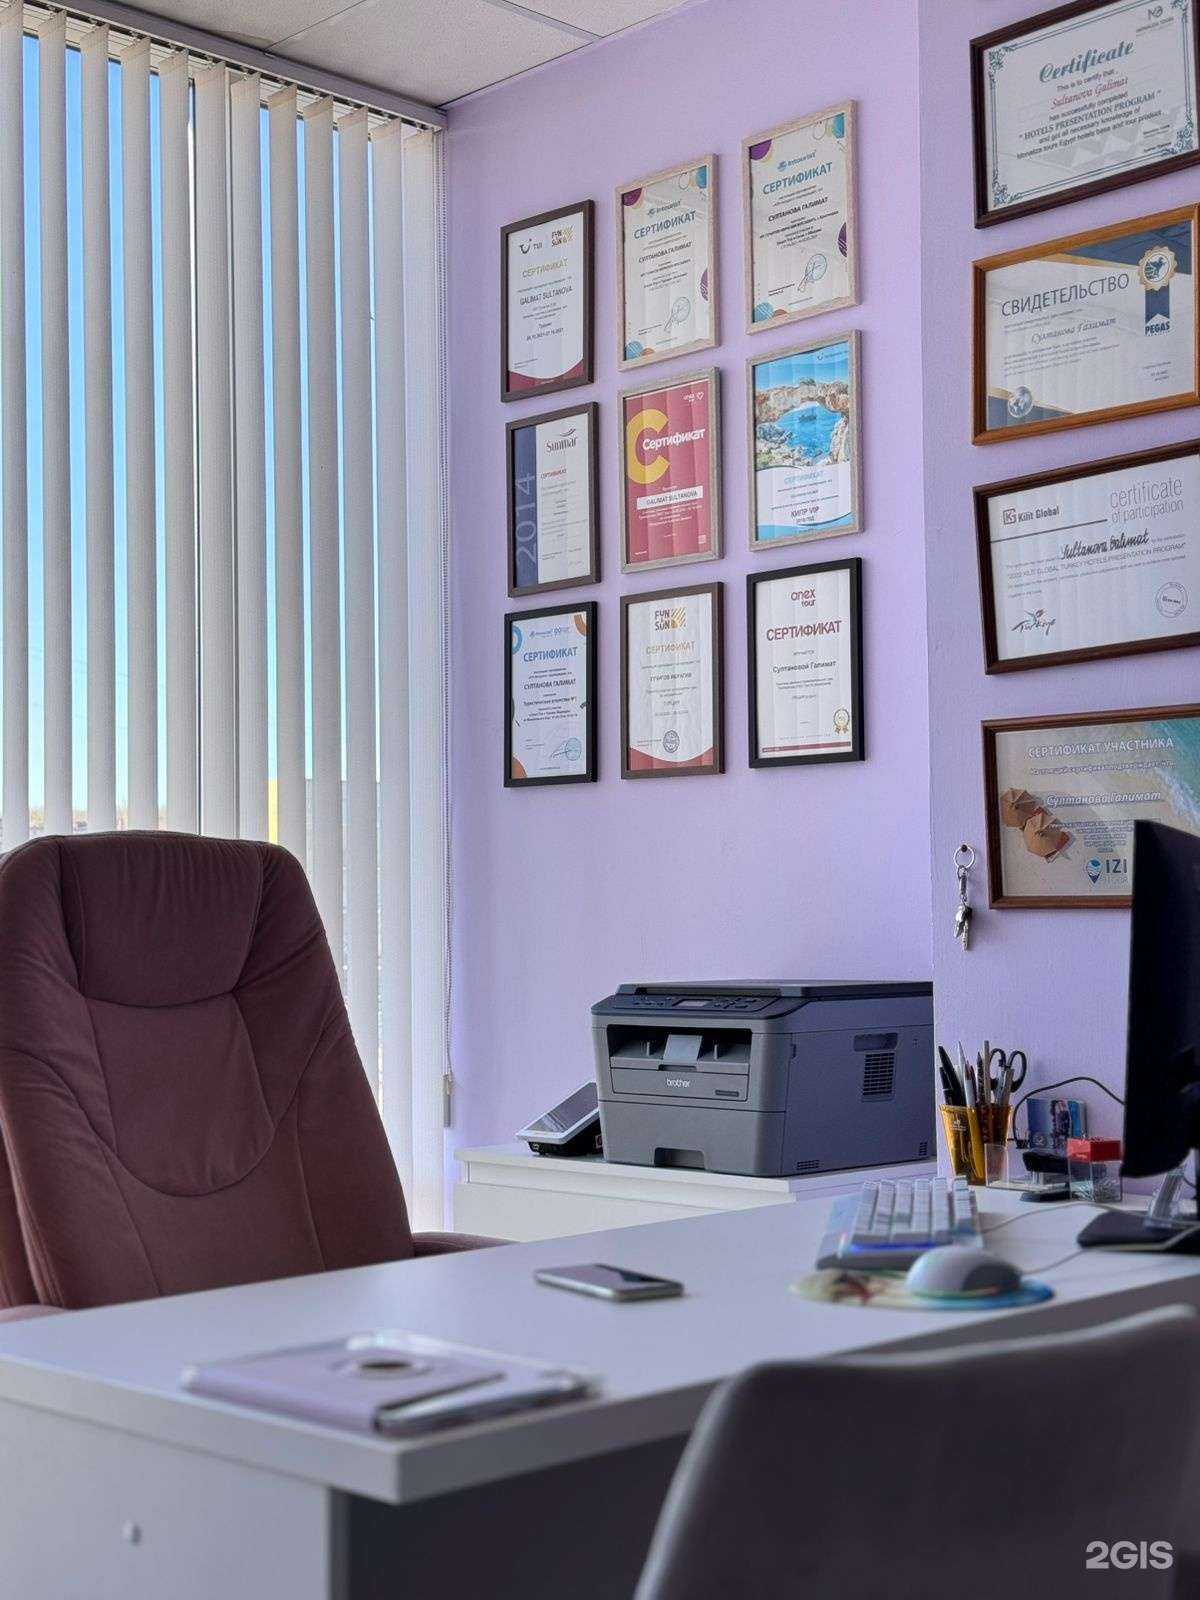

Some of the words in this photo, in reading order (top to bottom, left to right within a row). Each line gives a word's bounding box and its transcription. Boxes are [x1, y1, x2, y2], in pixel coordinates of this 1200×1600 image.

[1039, 40, 1134, 83] Certificate
[1024, 124, 1053, 139] HOTELS
[1055, 104, 1111, 130] PRESENTATION
[1113, 90, 1155, 111] PROGRAM
[762, 161, 833, 195] СЕРТИФИКАТ
[633, 210, 696, 239] СЕРТИФИКАТ
[1001, 273, 1130, 317] СВИДЕТЕЛЬСТВО
[1145, 320, 1171, 336] PEGAS
[642, 428, 706, 450] Сертификат
[1110, 476, 1183, 509] certificate
[515, 472, 537, 565] 2014
[1036, 506, 1060, 519] Global
[1111, 510, 1121, 524] of
[1123, 500, 1184, 524] participation
[655, 609, 670, 620] FUN
[655, 620, 670, 631] SUN
[766, 620, 842, 641] СЕРТИФИКАТ
[524, 647, 578, 662] СЕРТИФИКАТ
[646, 641, 695, 655] СЕРТИФИКАТ
[1029, 742, 1100, 758] СЕРТИФИКАТ
[1104, 736, 1174, 753] УЧАСТНИКА
[1105, 858, 1128, 874] IZI
[666, 1078, 691, 1088] brother
